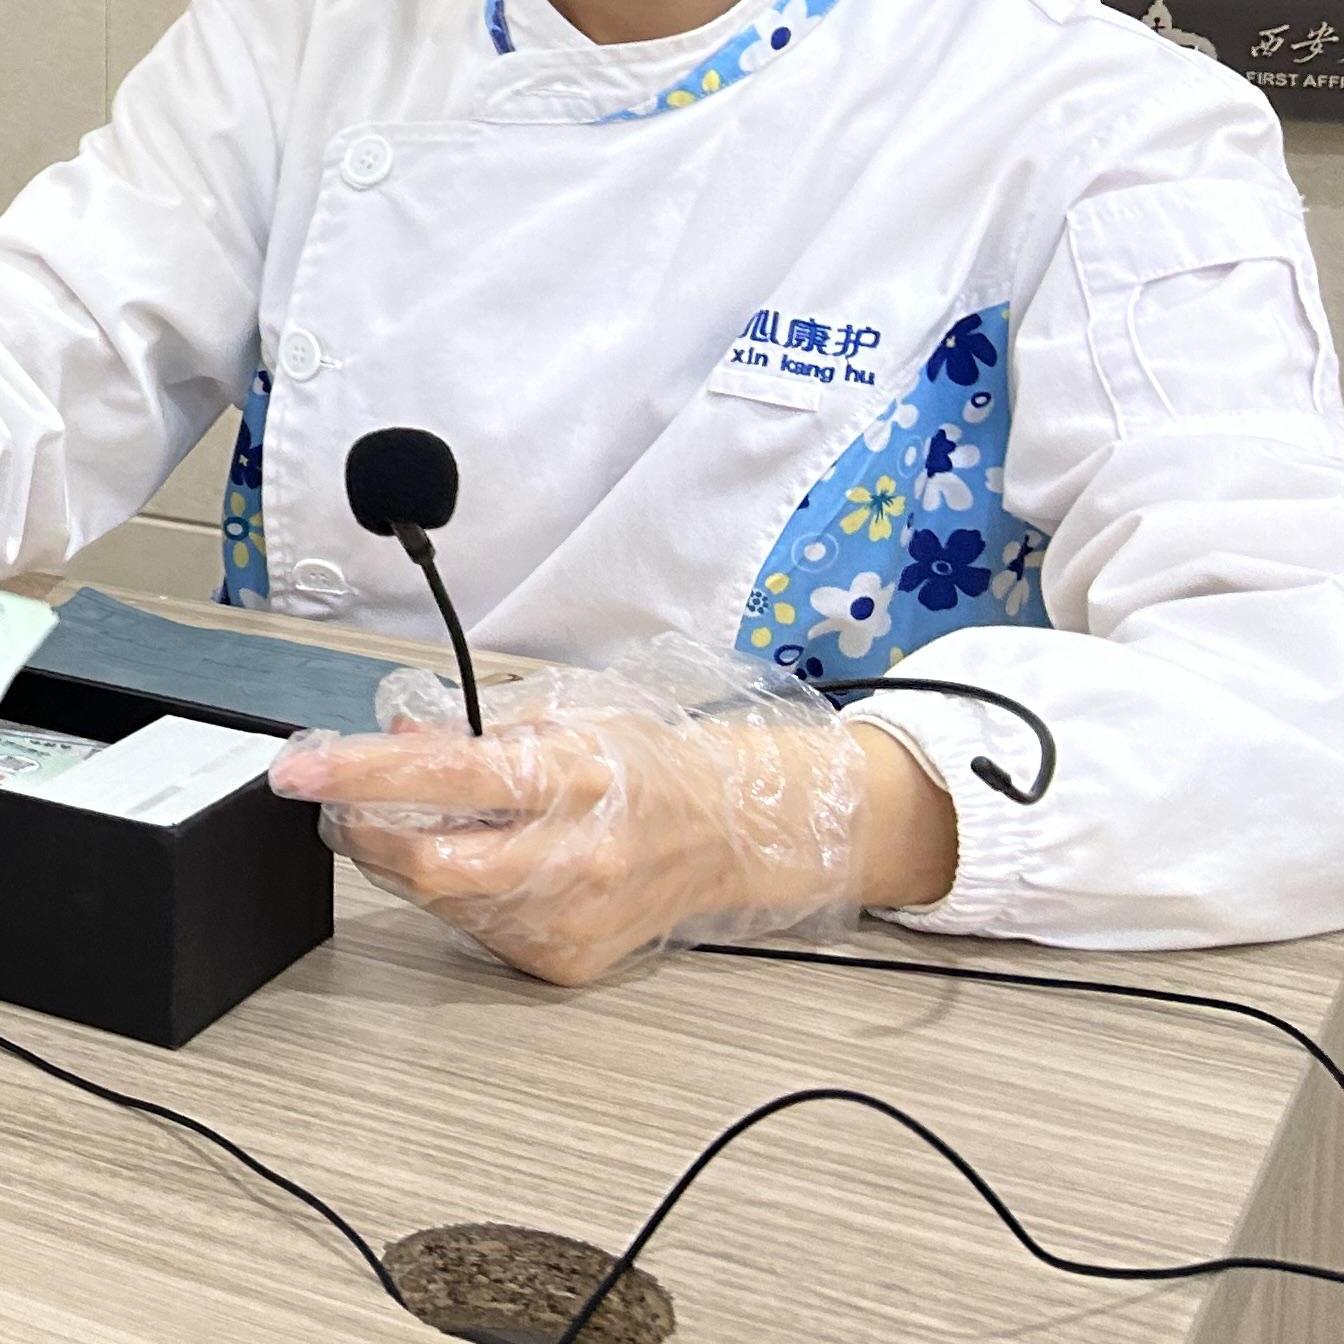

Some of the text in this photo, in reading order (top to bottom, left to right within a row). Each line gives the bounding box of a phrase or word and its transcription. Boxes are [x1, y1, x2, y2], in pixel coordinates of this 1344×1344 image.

[1251, 21, 1344, 64] 西安
[1246, 71, 1299, 87] FIRST
[730, 346, 875, 385] xin kang hu
